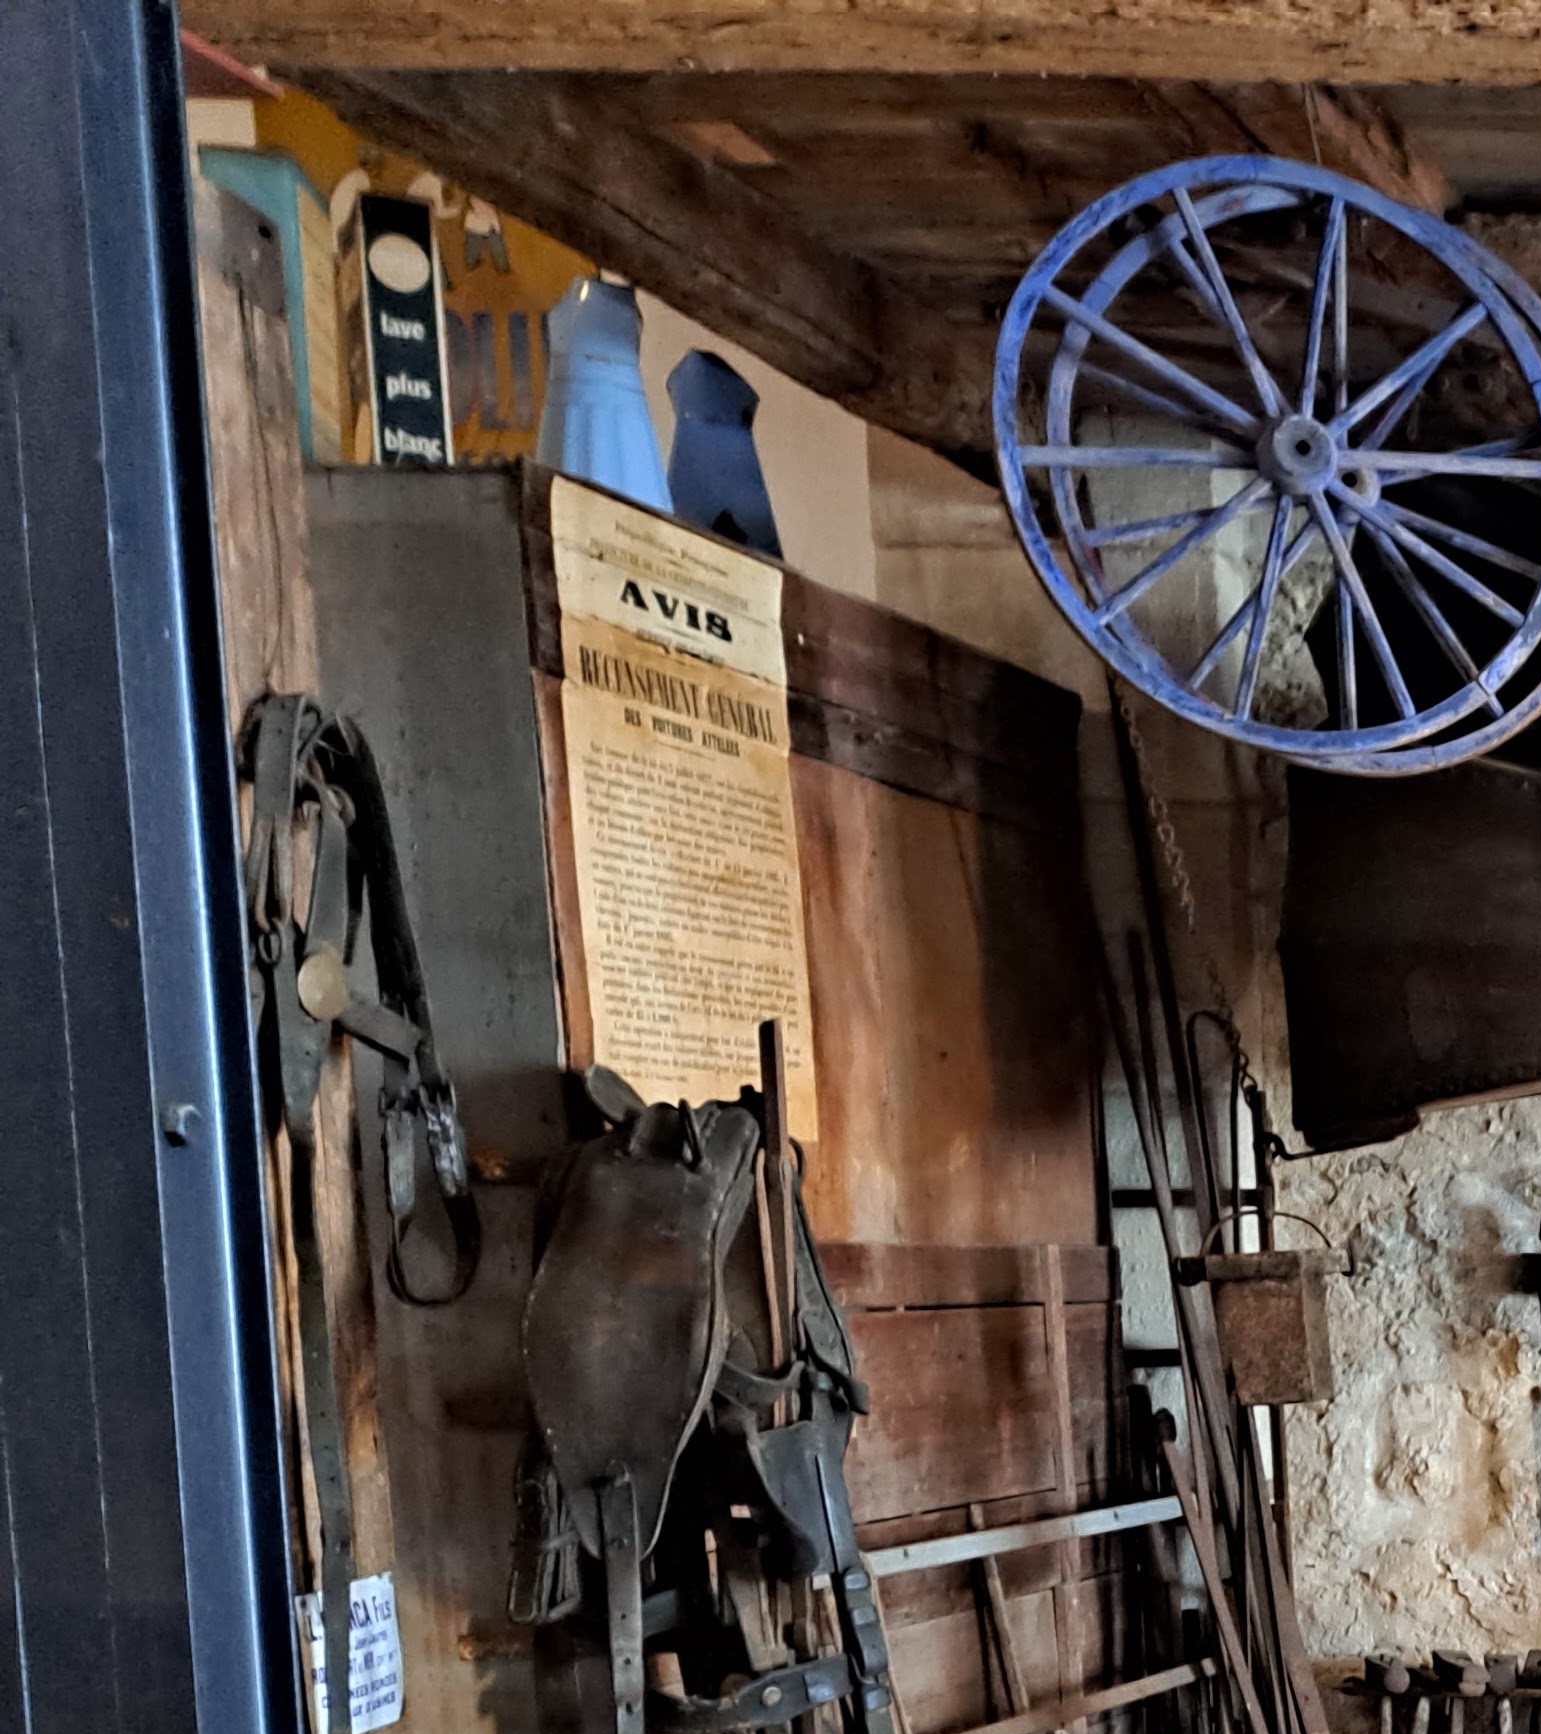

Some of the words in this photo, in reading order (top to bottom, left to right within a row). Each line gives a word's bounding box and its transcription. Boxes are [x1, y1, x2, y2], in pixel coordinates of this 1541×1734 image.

[380, 310, 425, 342] lave
[385, 371, 433, 400] plus
[383, 426, 443, 463] blanc
[619, 578, 733, 643] AVIS
[579, 644, 699, 719] RECENSEMENT
